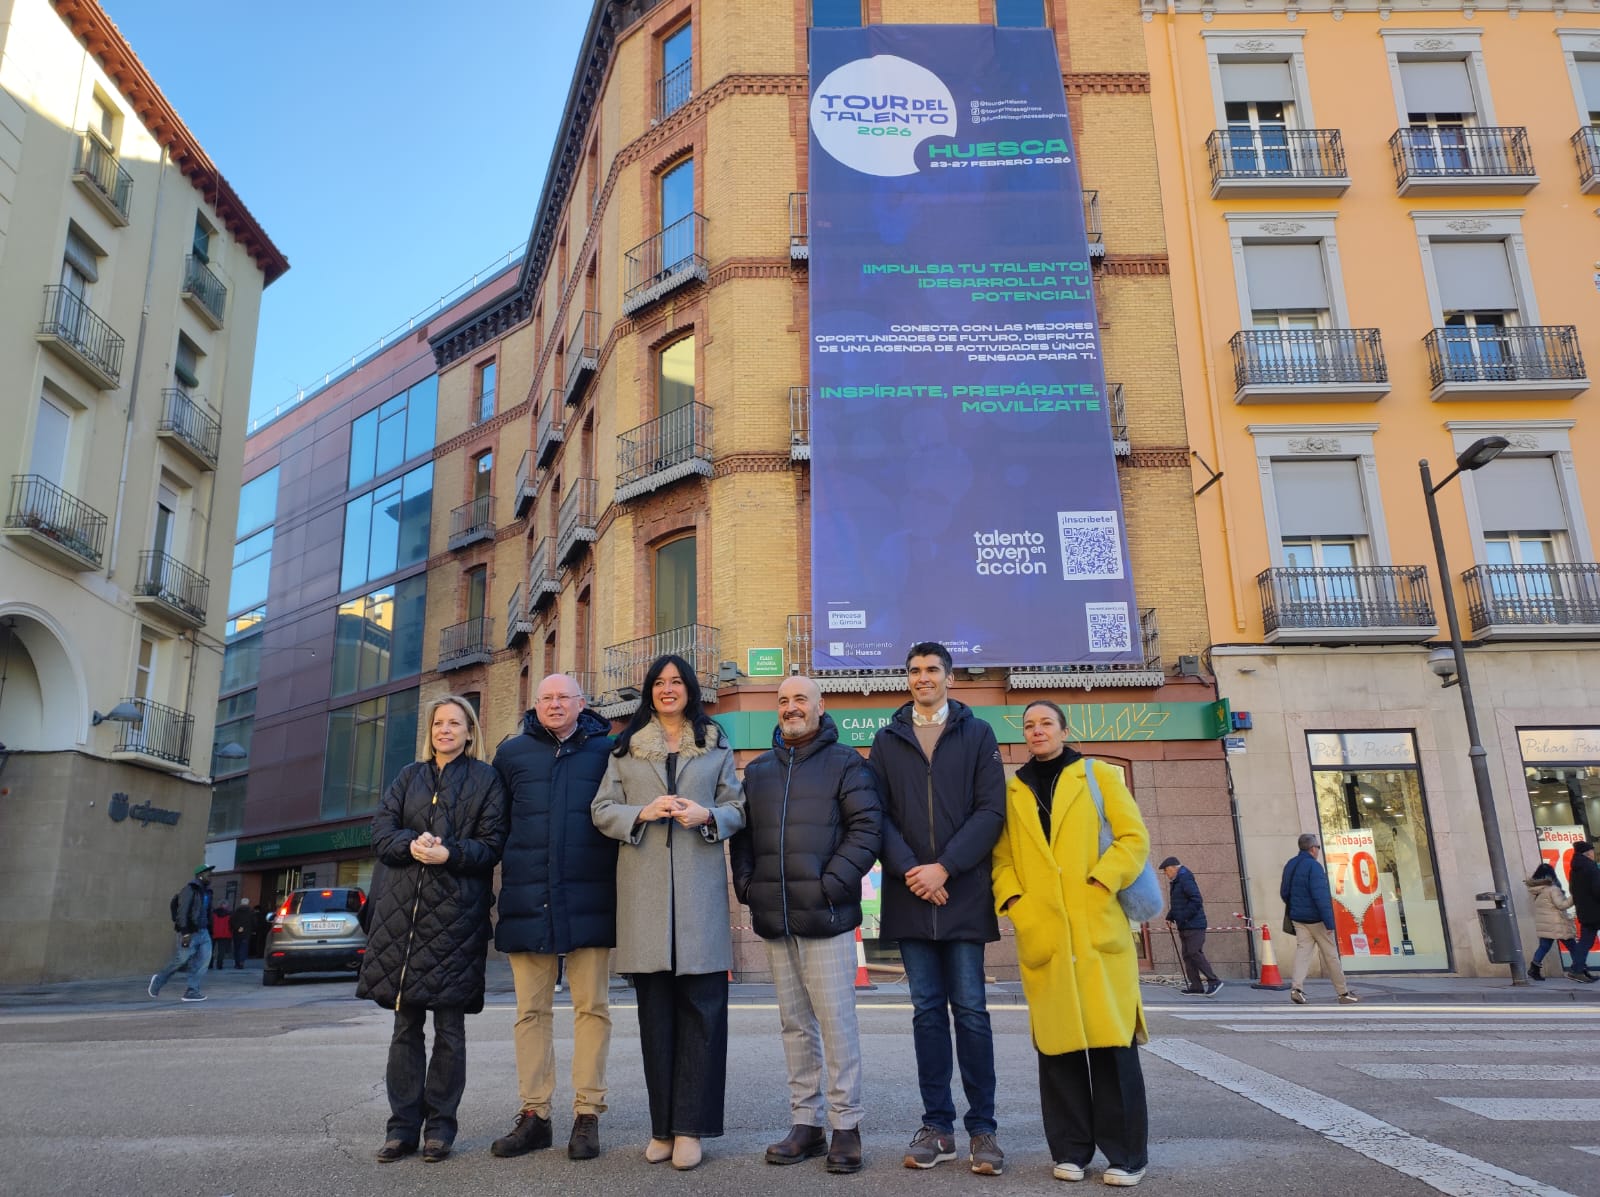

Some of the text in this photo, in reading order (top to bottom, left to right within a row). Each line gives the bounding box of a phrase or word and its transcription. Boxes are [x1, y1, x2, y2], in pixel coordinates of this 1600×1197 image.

[820, 95, 948, 110] TOUR DEL
[820, 110, 948, 124] TALENTO
[857, 126, 911, 136] 2026
[928, 138, 1069, 158] HUESCA
[970, 158, 1033, 167] FEBRERO
[1035, 156, 1071, 165] 2026
[957, 263, 986, 273] TU
[990, 261, 1088, 273] TALENTO!
[1061, 275, 1089, 286] TU
[971, 289, 1090, 302] POTENCIAL!
[890, 322, 1093, 332] CONECTA CON LAS MEJORES
[815, 332, 1094, 342] OPORTUNIDADES DE FUTURO, DISFRUTA
[819, 341, 1096, 353] DE UNA AGENDA DE ACTIVIDADES ÚNICA
[968, 352, 1097, 362] PENSADA PARA TI.
[820, 382, 1099, 399] INSPÍRATE, PREPÁRATE,
[962, 398, 1100, 413] MOVILÍZATE
[974, 529, 1044, 546] talento
[976, 546, 1046, 563] joven en
[845, 641, 893, 650] Ayuntamiento
[842, 718, 875, 729] CAJA
[851, 732, 865, 740] DE
[1525, 737, 1568, 754] Pilar
[1335, 834, 1373, 847] Rebajas
[1544, 831, 1585, 843] Rebajas
[1326, 851, 1379, 895] 70
